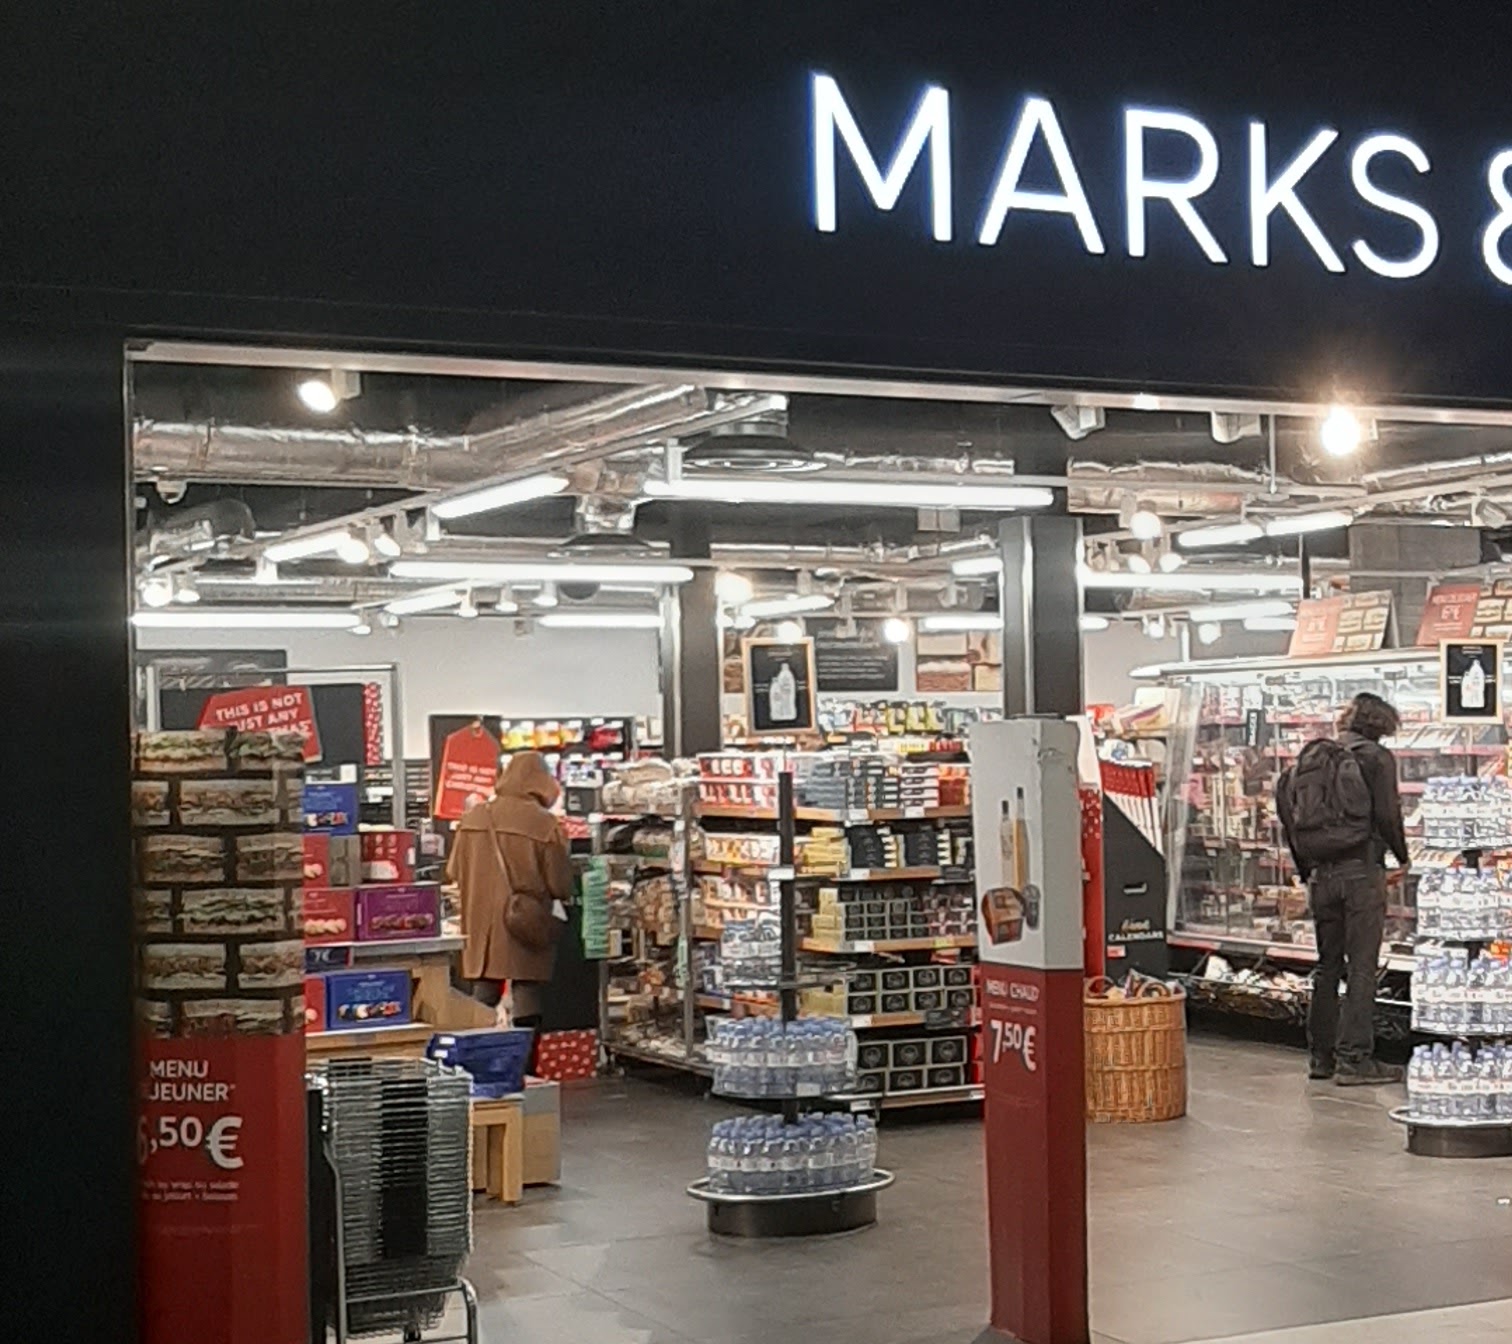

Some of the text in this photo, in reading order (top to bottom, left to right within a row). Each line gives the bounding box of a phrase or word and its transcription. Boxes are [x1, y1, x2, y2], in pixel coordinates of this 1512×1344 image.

[812, 73, 1440, 279] MARKS
[216, 703, 250, 721] THIS
[271, 692, 303, 709] NOT
[990, 1019, 1037, 1071] 7,50€
[149, 1060, 209, 1078] MENU
[144, 1082, 235, 1101] JEUNER
